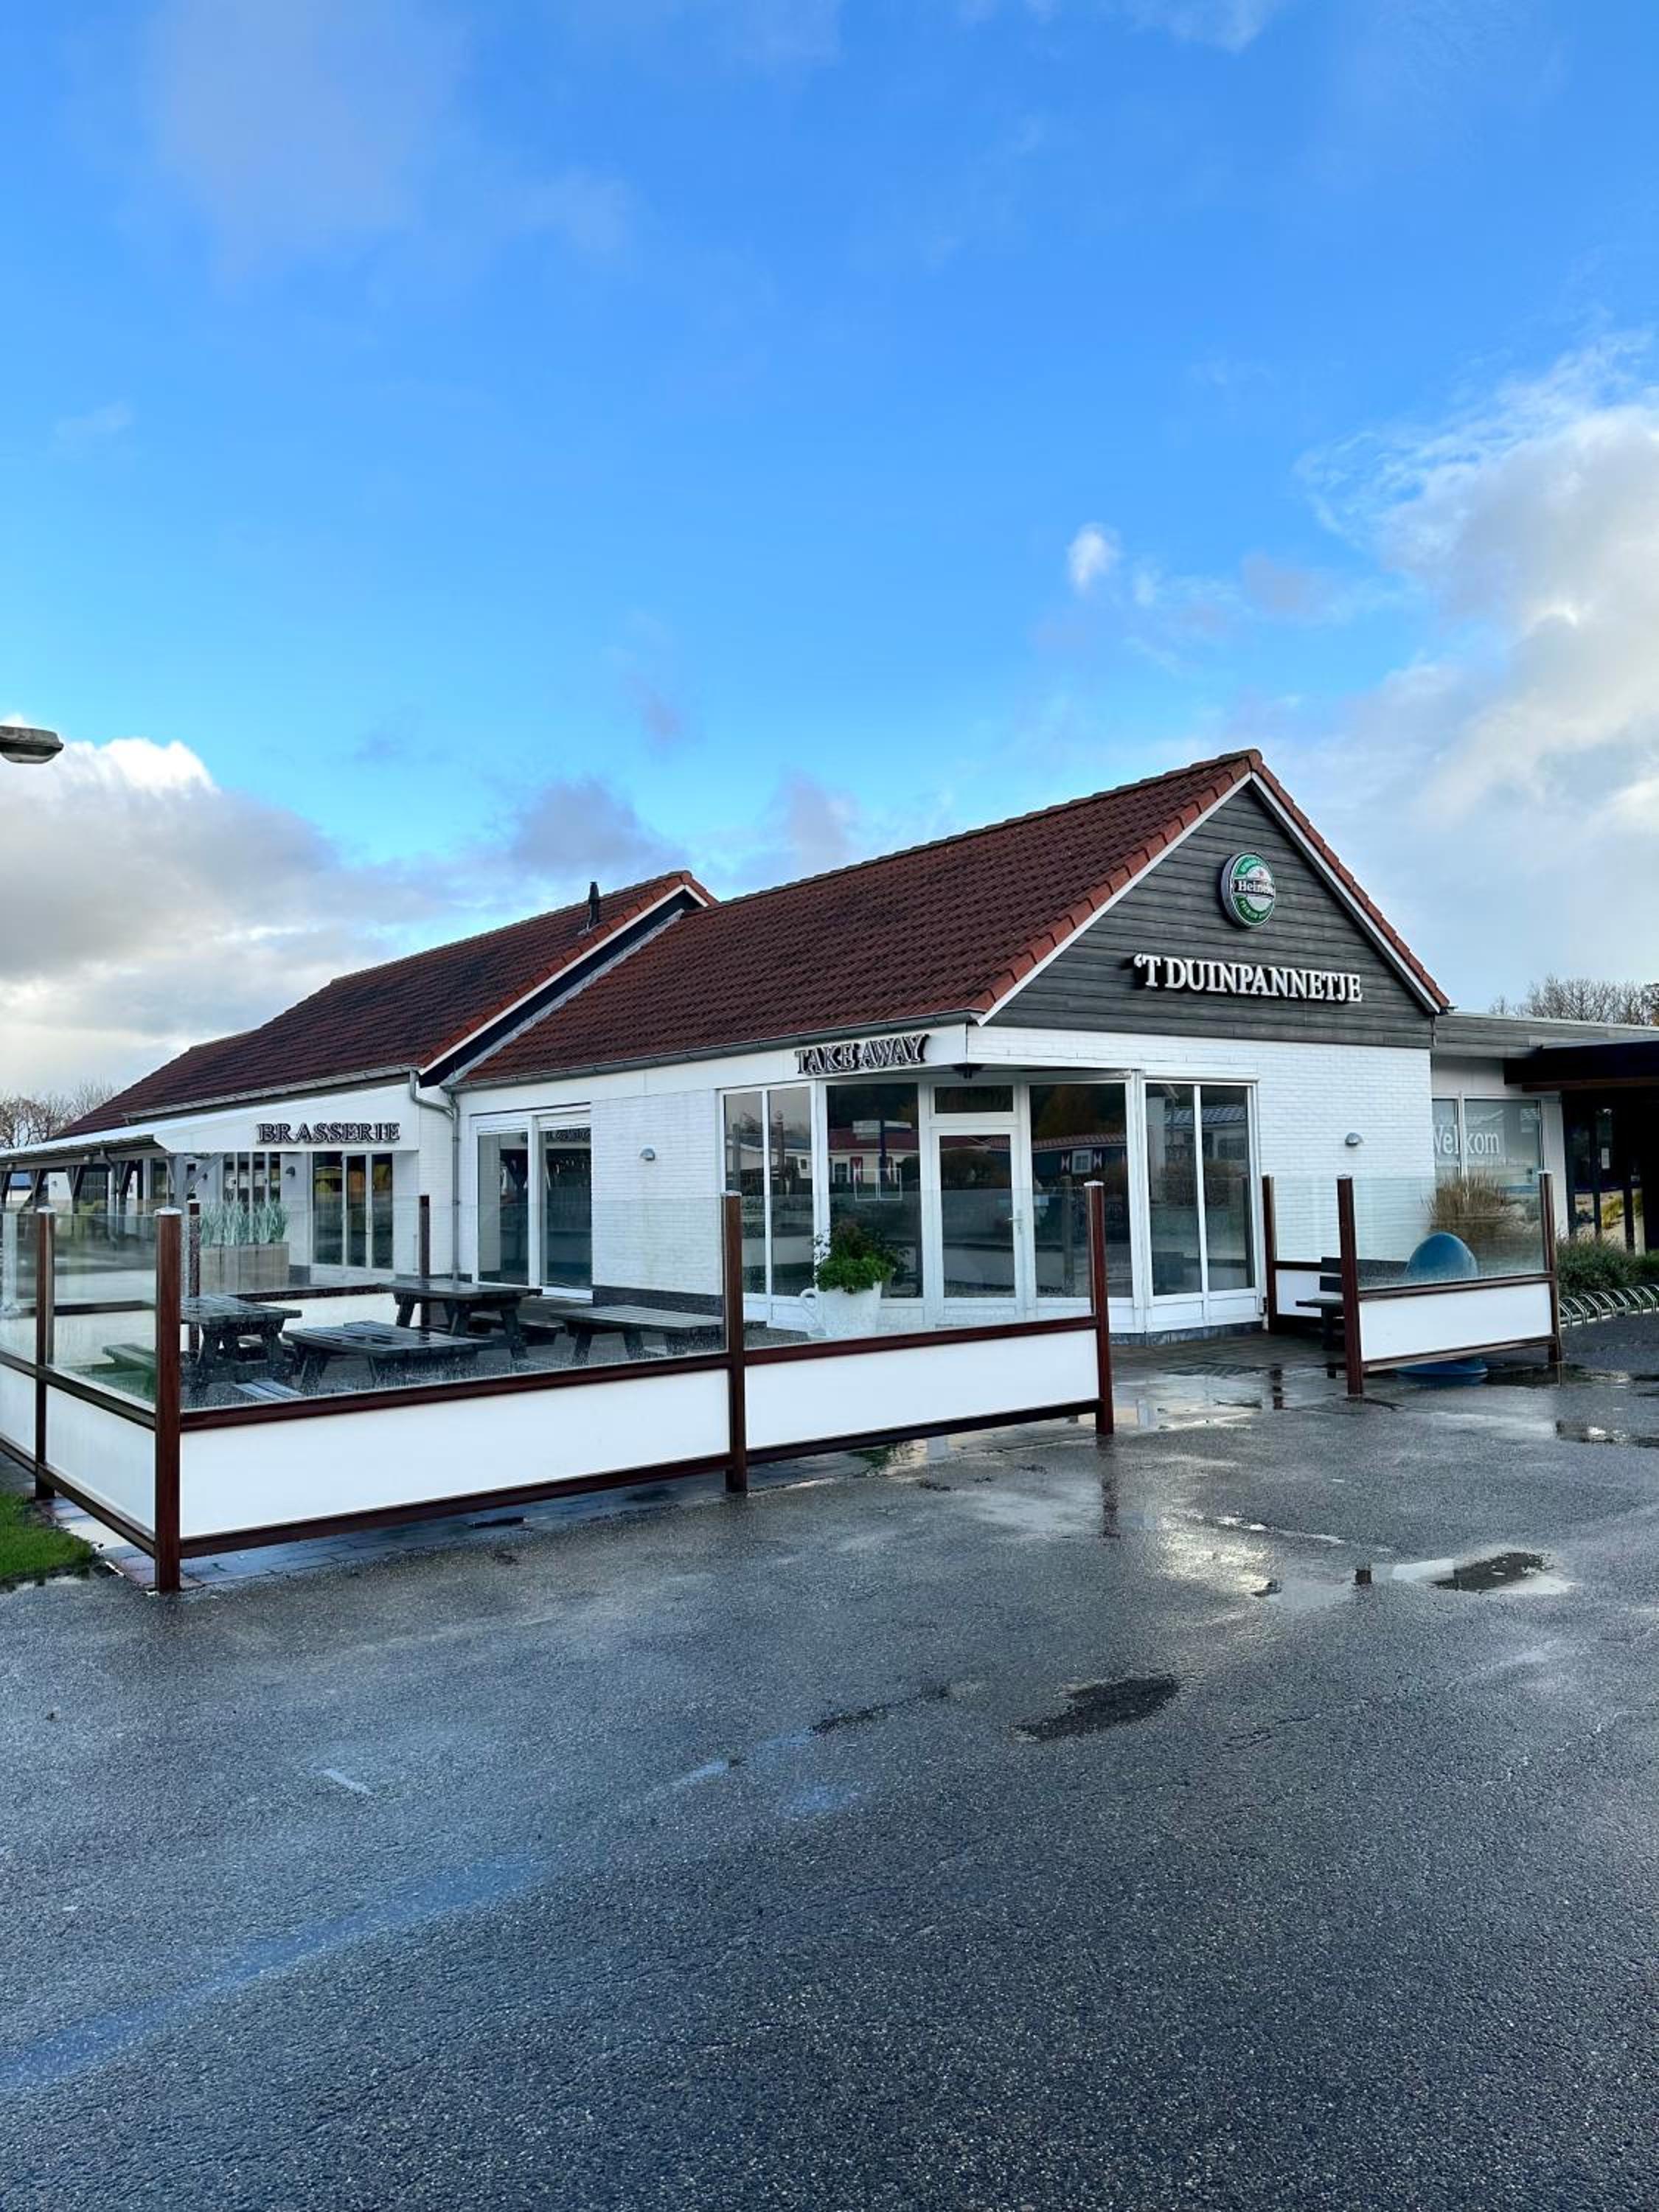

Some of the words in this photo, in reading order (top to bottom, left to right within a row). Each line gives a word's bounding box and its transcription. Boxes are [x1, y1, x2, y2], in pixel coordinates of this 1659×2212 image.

[1164, 958, 1363, 1003] DUINPANNETJE
[795, 1043, 855, 1075] TAKE
[858, 1034, 928, 1068] AWAY
[258, 1122, 401, 1144] BRASSERIE
